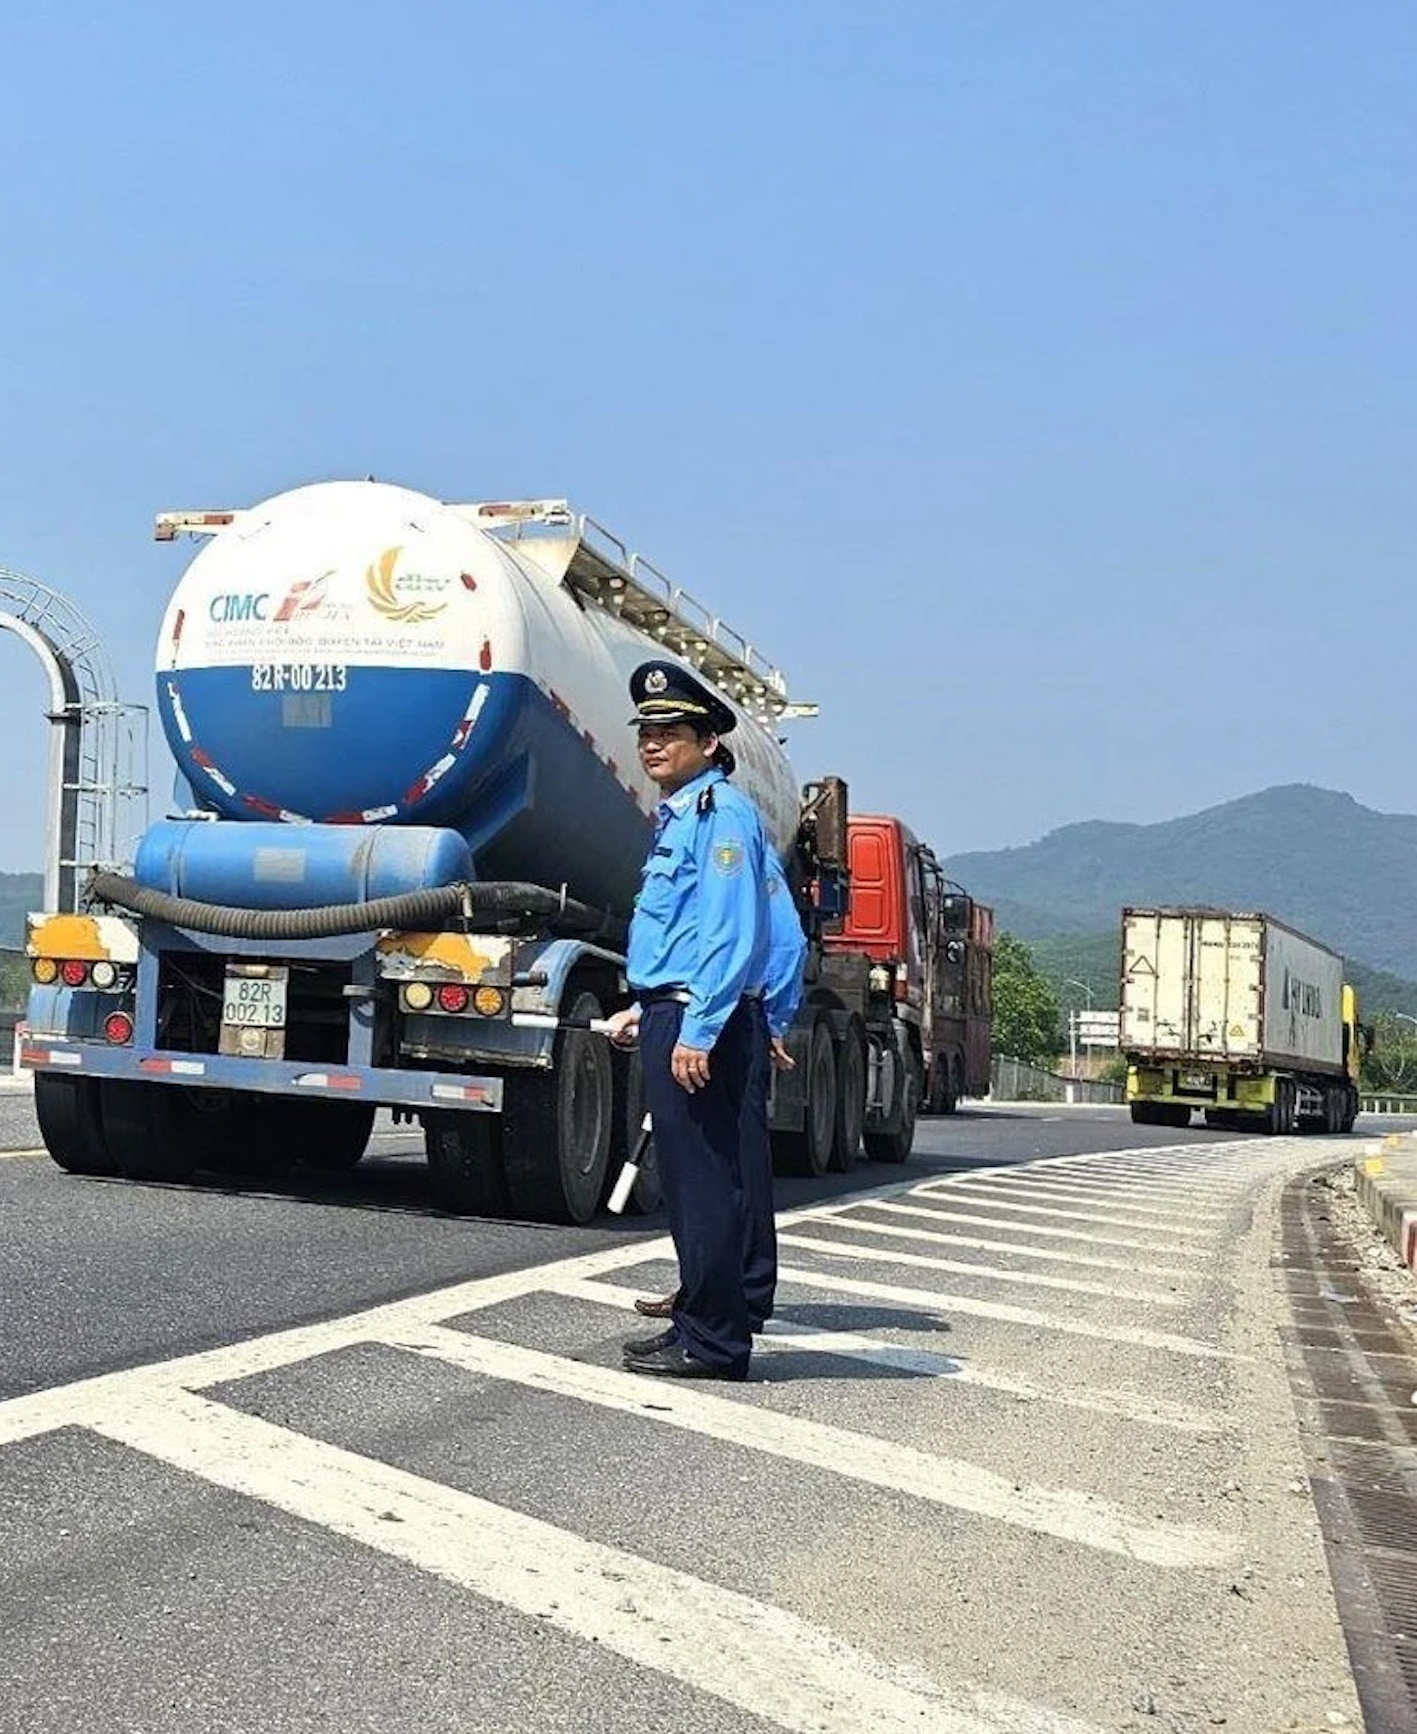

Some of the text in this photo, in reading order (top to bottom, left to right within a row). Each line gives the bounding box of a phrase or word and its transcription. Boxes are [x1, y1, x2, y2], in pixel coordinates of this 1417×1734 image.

[209, 593, 270, 622] CIMC
[239, 982, 272, 1002] 82R
[226, 1002, 283, 1023] 002.13
